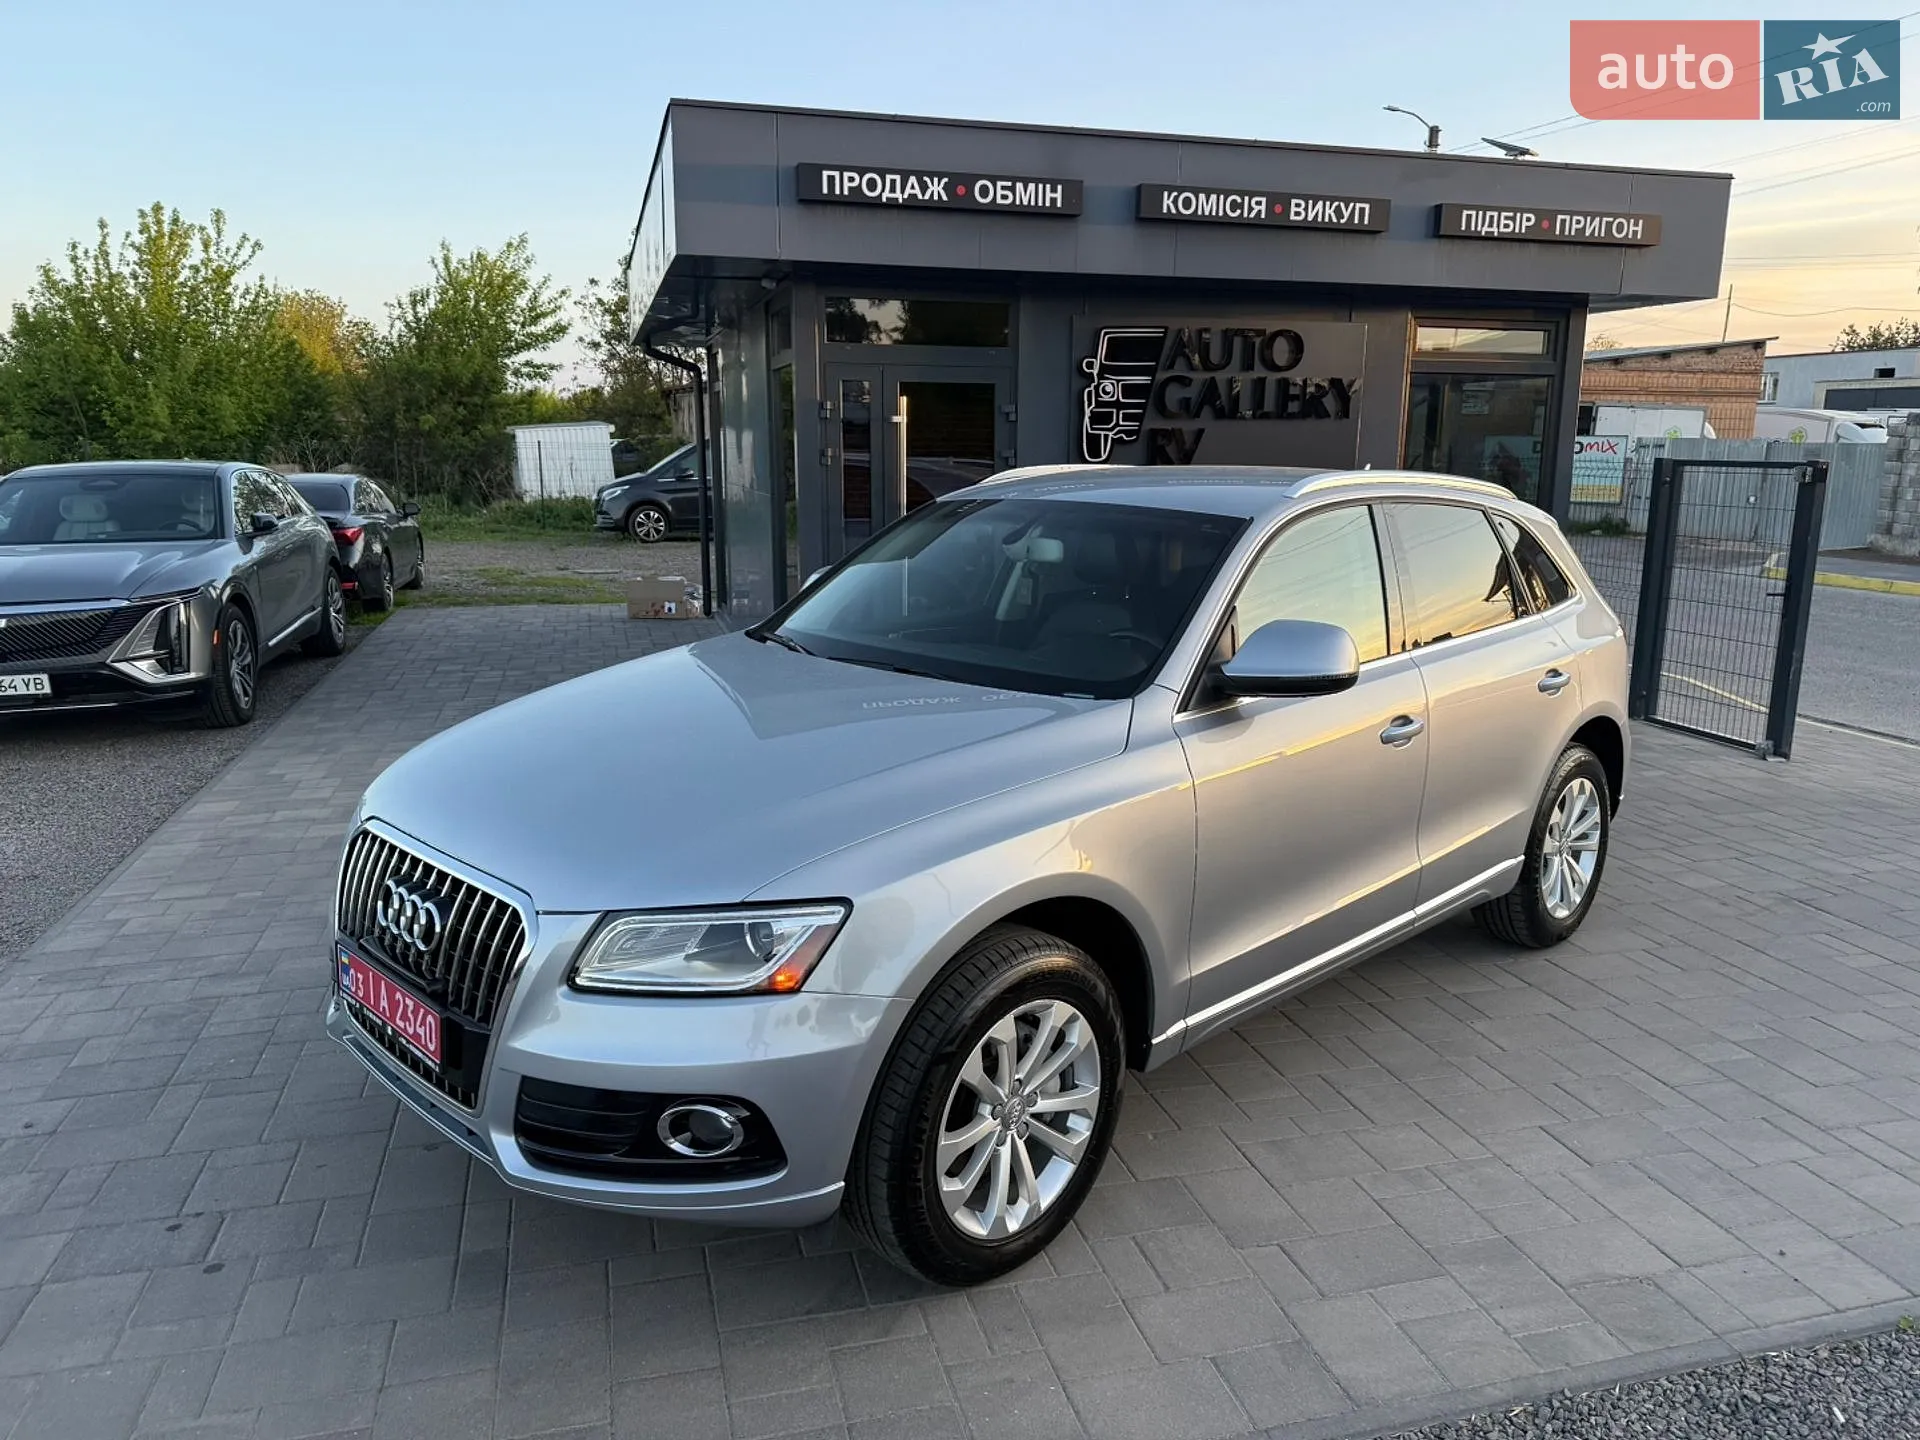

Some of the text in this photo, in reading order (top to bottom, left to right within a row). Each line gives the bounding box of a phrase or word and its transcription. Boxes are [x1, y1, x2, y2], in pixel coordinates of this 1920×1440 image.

[821, 170, 1064, 208] ПРОДАЖ ОБМІН
[1161, 191, 1371, 225] КОМІСІЯ ВИКУП
[1460, 209, 1644, 240] ПІДБІР ПРИГОН
[1163, 326, 1305, 372] AUTO
[1152, 375, 1362, 420] GALLERY
[1146, 427, 1205, 465] RV
[21, 677, 45, 692] YB
[349, 967, 364, 998] 03
[395, 991, 437, 1052] 2340
